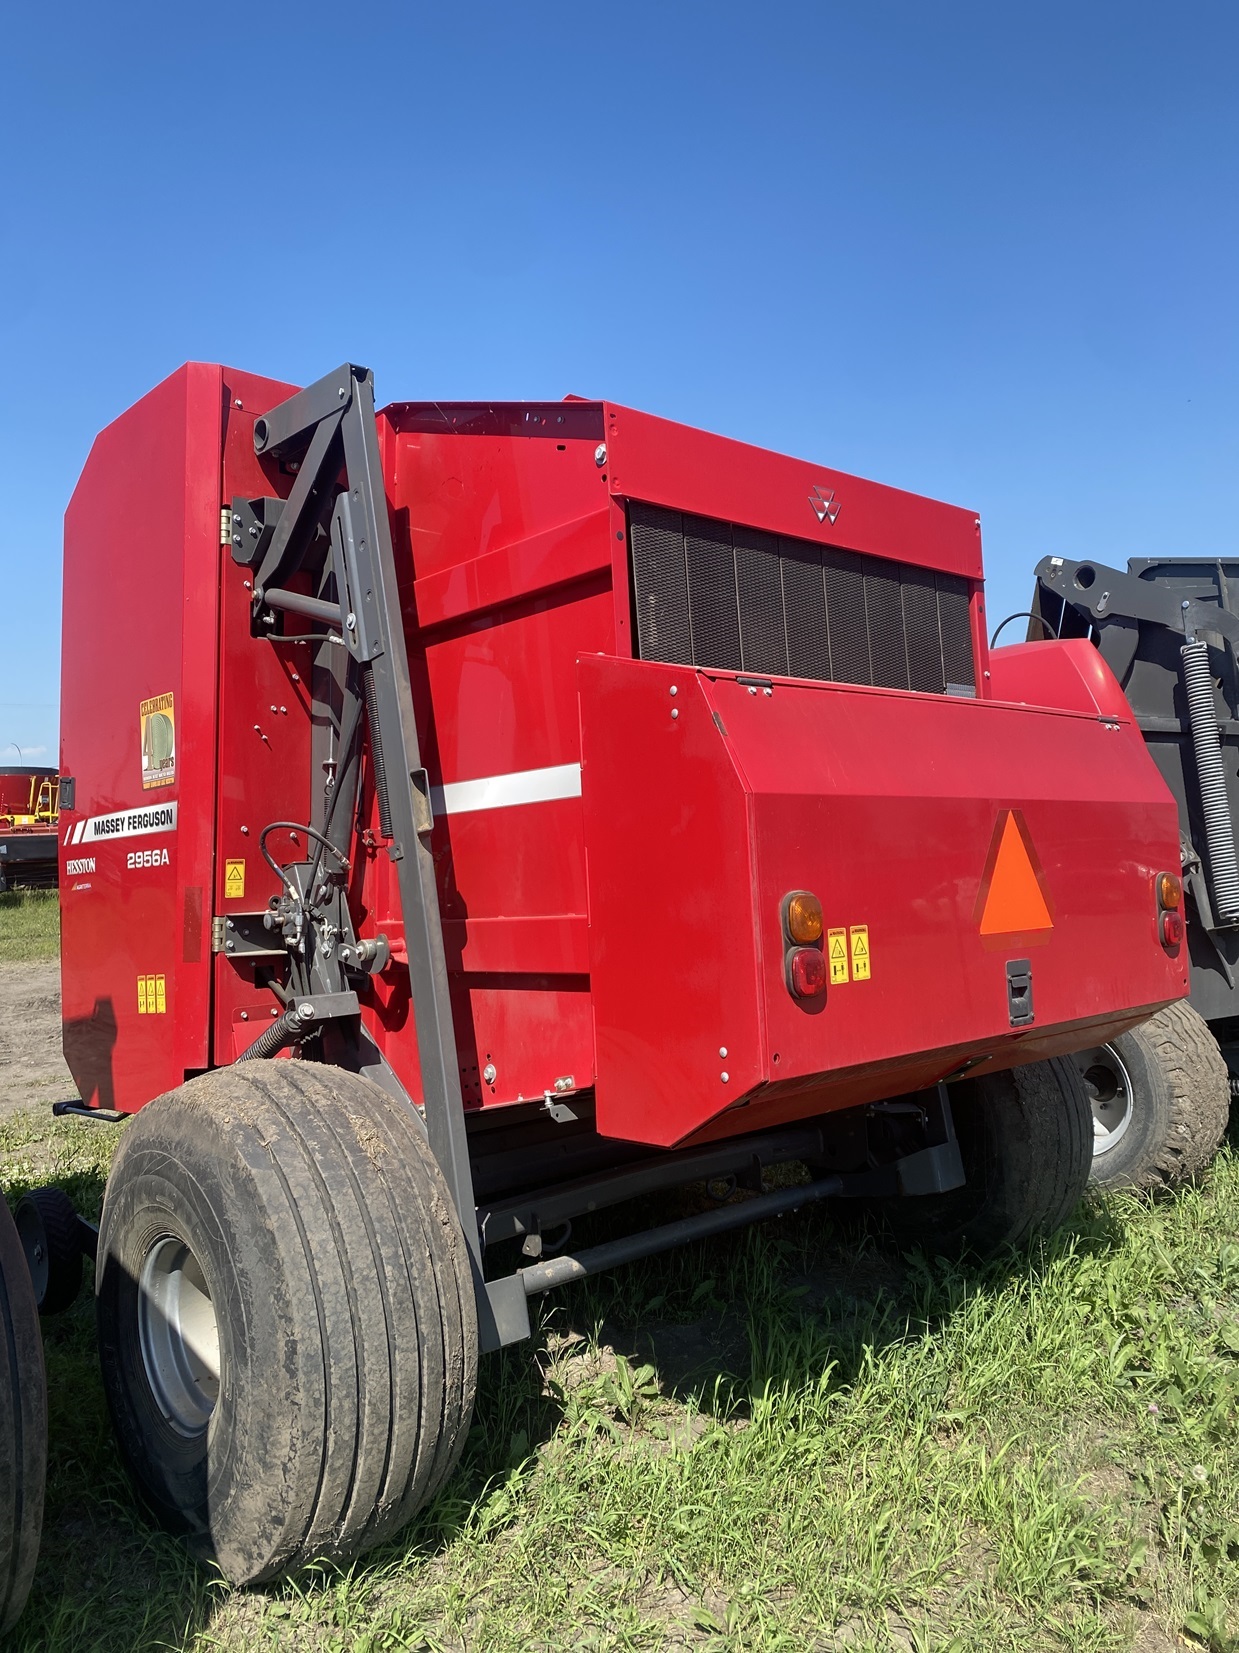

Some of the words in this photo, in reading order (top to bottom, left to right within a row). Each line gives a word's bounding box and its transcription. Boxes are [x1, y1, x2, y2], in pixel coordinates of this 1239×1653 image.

[141, 693, 173, 717] CELEBRATING
[160, 756, 174, 771] years
[94, 817, 126, 836] MASSEY
[127, 808, 173, 831] FERGUSON
[66, 857, 96, 876] HESSTON
[127, 848, 170, 869] 2956A
